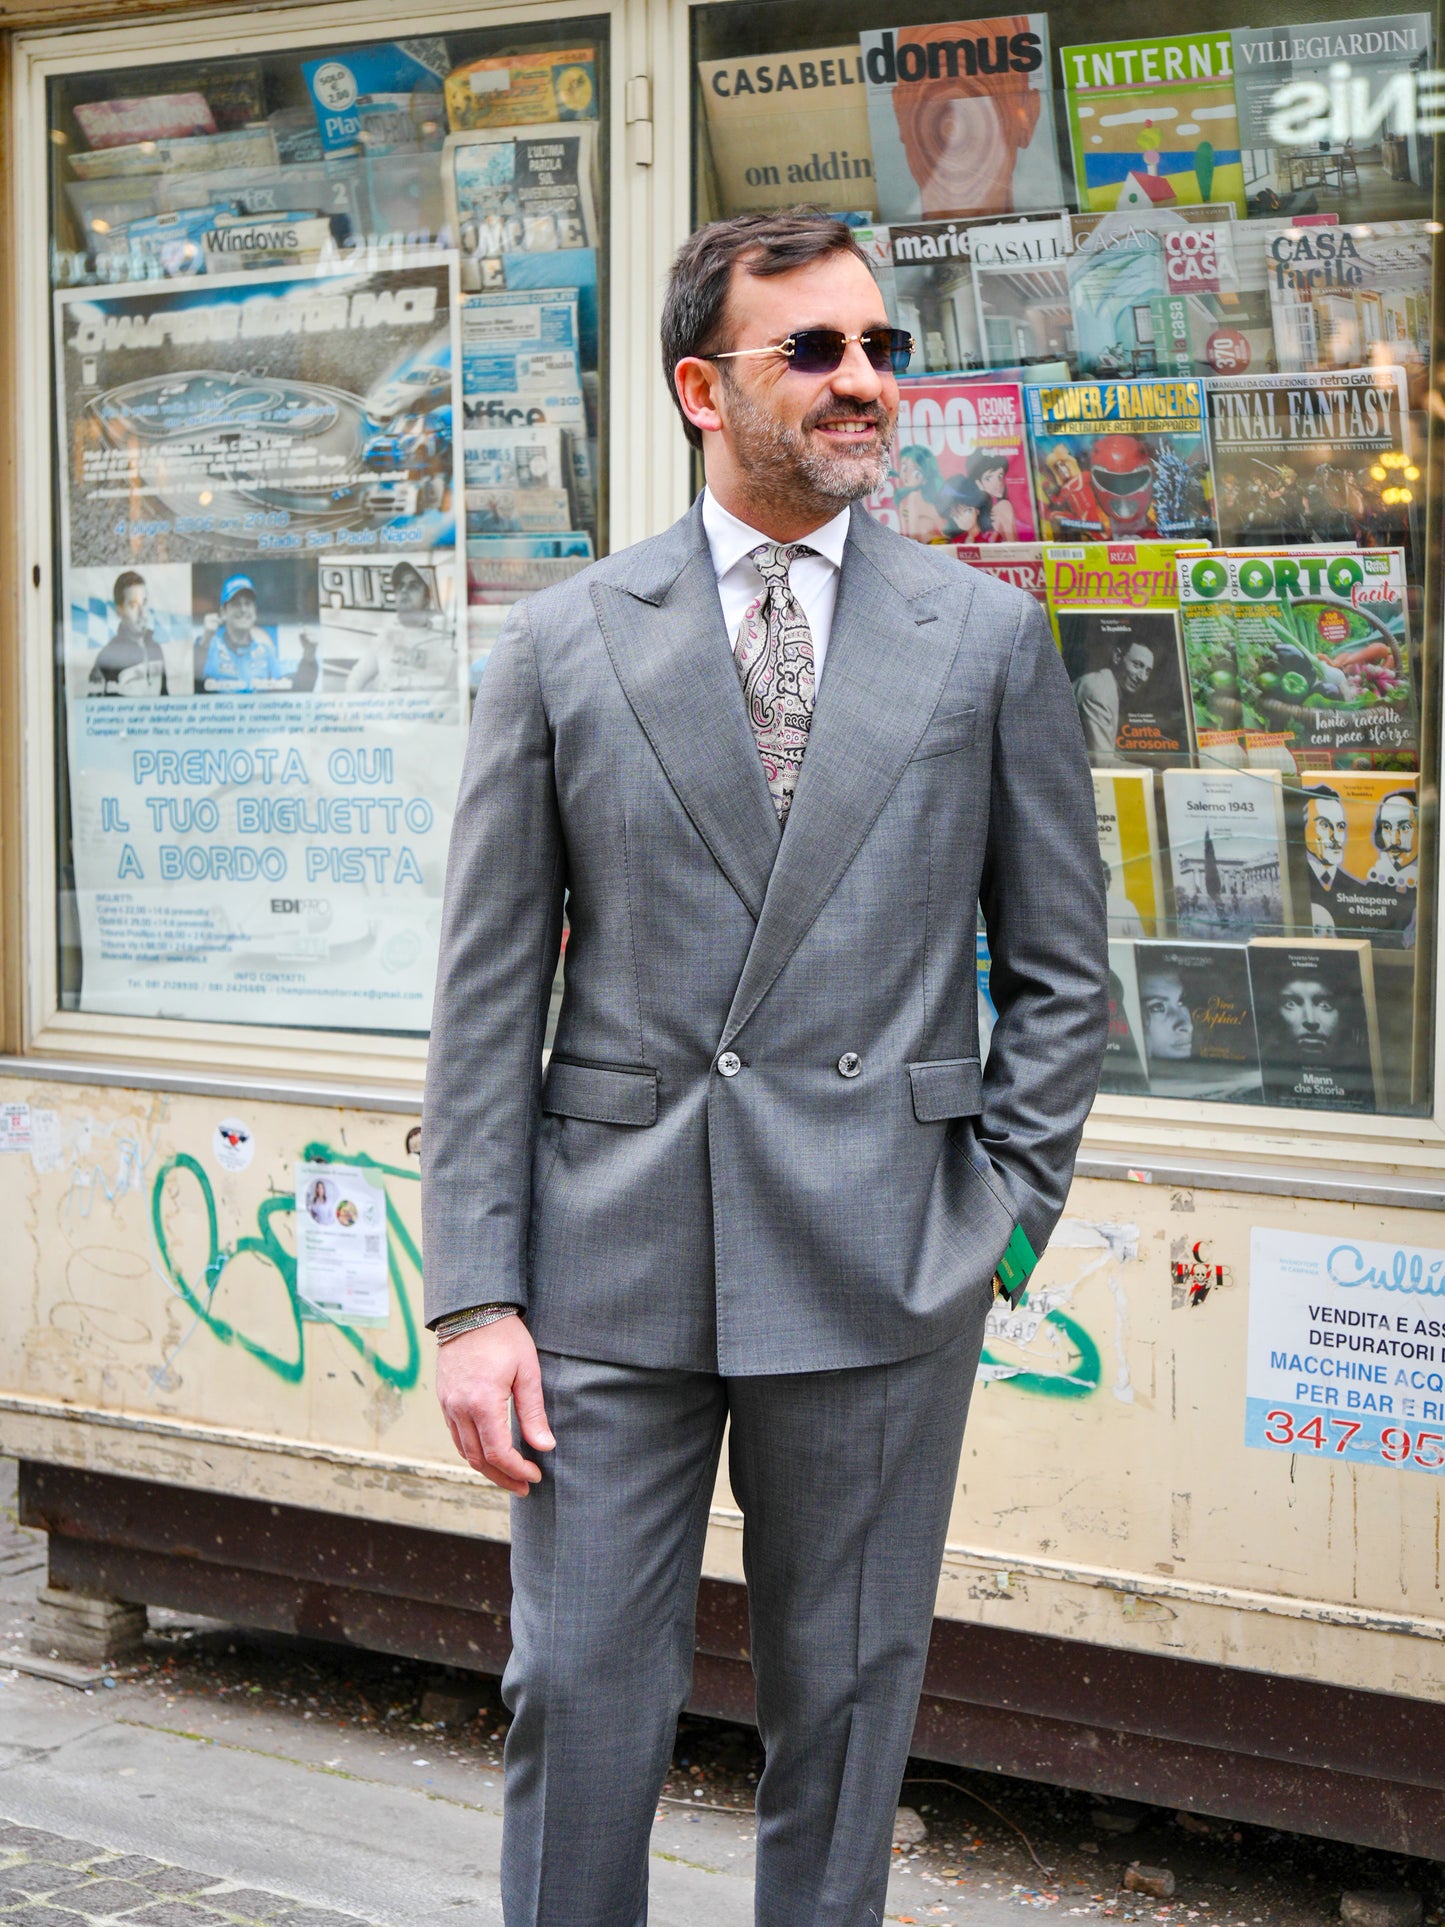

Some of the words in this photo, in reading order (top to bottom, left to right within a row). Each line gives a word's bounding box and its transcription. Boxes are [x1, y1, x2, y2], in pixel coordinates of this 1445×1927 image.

[867, 31, 1043, 85] domus
[1240, 28, 1419, 65] VILLEGIARDINI
[319, 71, 346, 86] SOLO
[1072, 40, 1233, 89] INTERNI
[745, 165, 781, 187] on
[787, 151, 876, 185] addin
[205, 228, 299, 252] Windows
[895, 225, 971, 260] marie
[1165, 228, 1227, 257] COSE
[1272, 232, 1360, 262] CASA
[1168, 254, 1236, 281] CASA
[1276, 259, 1364, 289] facile
[350, 287, 437, 327] RACE
[1169, 301, 1187, 338] casa
[1213, 338, 1236, 369] 370
[1212, 381, 1246, 389] MANUALI
[1247, 380, 1258, 388] DA
[1258, 379, 1308, 388] COLLEZIONE
[1309, 378, 1317, 386] DI
[1320, 376, 1350, 386] retro
[1350, 374, 1394, 385] GAMER
[977, 397, 1016, 415] ICONE
[1039, 386, 1103, 420] POWER
[1117, 382, 1200, 419] RANGERS
[1211, 392, 1283, 440] FINAL
[1287, 388, 1394, 440] FANTASY
[979, 415, 1017, 437] SEXY
[1069, 422, 1092, 433] ALTRI
[1095, 422, 1113, 432] LIVE
[1114, 421, 1145, 432] ACTION
[1147, 419, 1199, 431] GIAPPONESI
[1372, 442, 1394, 450] TEMPI
[258, 532, 302, 551] Stadio
[306, 530, 334, 547] San
[337, 528, 376, 546] Paolo
[379, 526, 424, 544] Napoli
[1110, 549, 1135, 562] RIZA
[1181, 564, 1191, 598] ORTO
[1230, 564, 1239, 598] ORTO
[1238, 557, 1364, 600] ORTO
[1351, 580, 1397, 609] facile
[1121, 724, 1162, 738] Canta
[1315, 710, 1349, 730] Tanto
[1350, 707, 1403, 728] raccolto
[1116, 737, 1179, 750] Carosone
[1311, 733, 1332, 745] con
[1335, 731, 1365, 748] poco
[1369, 726, 1411, 746] sforzo
[133, 748, 309, 785] PRENOTA
[328, 748, 394, 785] QUI
[101, 798, 130, 832] IL
[146, 798, 220, 833] TUO
[236, 798, 434, 835] BIGLIETTO
[1186, 800, 1227, 812] Salerno
[1228, 802, 1256, 813] 1943
[117, 843, 144, 881] A
[159, 845, 288, 882] BORDO
[305, 846, 424, 884] PISTA
[1336, 892, 1398, 907] Shakespeare
[1356, 906, 1388, 917] Napoli
[1192, 1004, 1247, 1030] Sophia!
[1294, 1083, 1312, 1094] che
[1313, 1085, 1345, 1097] Storia
[1303, 1073, 1333, 1086] Mann
[1327, 1244, 1445, 1299] Culli
[1308, 1304, 1391, 1332] VENDITA
[1396, 1316, 1409, 1333] E
[1308, 1329, 1434, 1363] DEPURATORI
[1270, 1351, 1388, 1386] MACCHINE
[1394, 1368, 1444, 1394] ACQ
[1296, 1381, 1339, 1407] PER
[1347, 1389, 1394, 1415] BAR
[1401, 1397, 1416, 1418] E
[1422, 1400, 1444, 1422] RI
[1264, 1410, 1362, 1455] 347
[1380, 1426, 1445, 1469] 95
